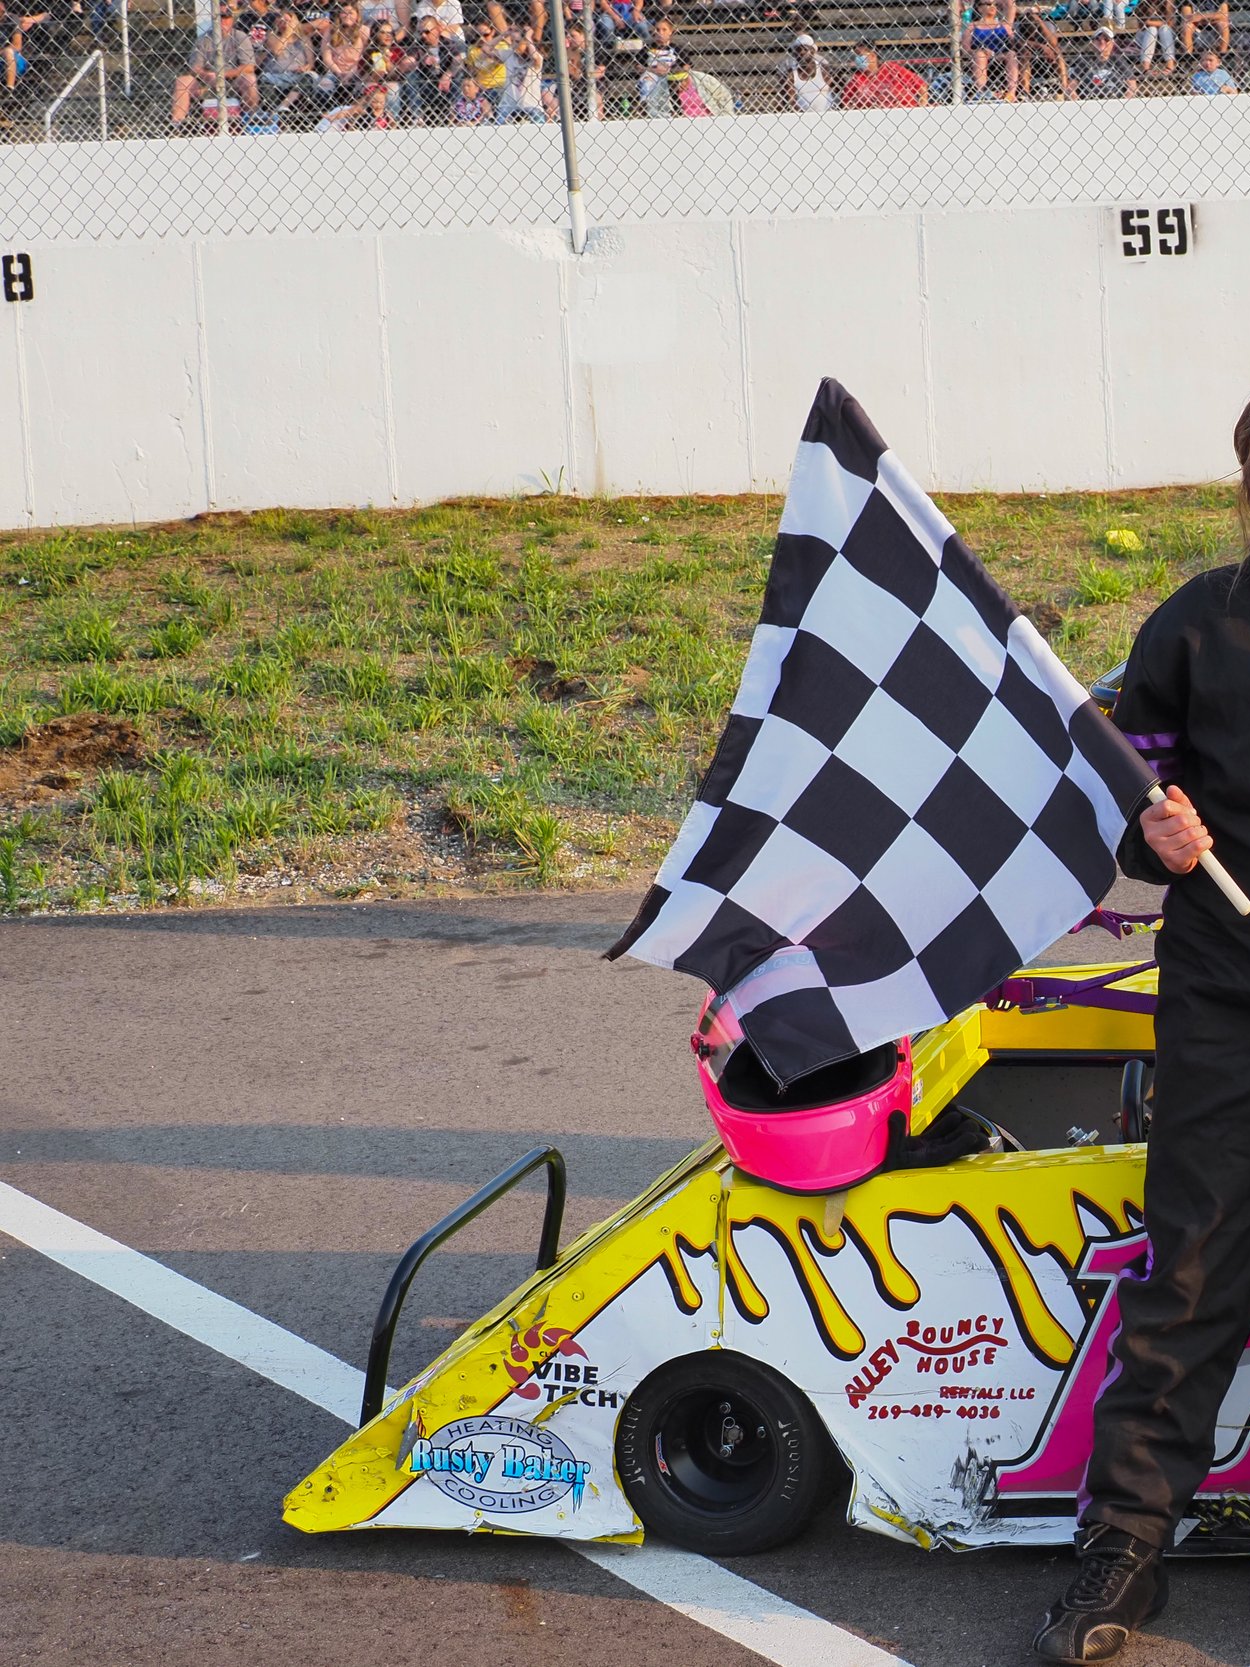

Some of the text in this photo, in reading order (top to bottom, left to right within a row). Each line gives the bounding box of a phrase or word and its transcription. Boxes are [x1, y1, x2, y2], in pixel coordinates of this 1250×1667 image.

[1121, 208, 1187, 256] 59
[2, 253, 34, 302] 8
[906, 1315, 1004, 1344] BOUNCY
[532, 1361, 598, 1385] VIBE
[845, 1338, 900, 1410] ALLEY
[916, 1347, 998, 1375] HOUSE
[543, 1384, 618, 1409] TECH
[1010, 1387, 1036, 1400] LLC
[448, 1419, 554, 1446] HEATING
[410, 1437, 590, 1485] Rusty Baker
[444, 1479, 557, 1510] COOLING
